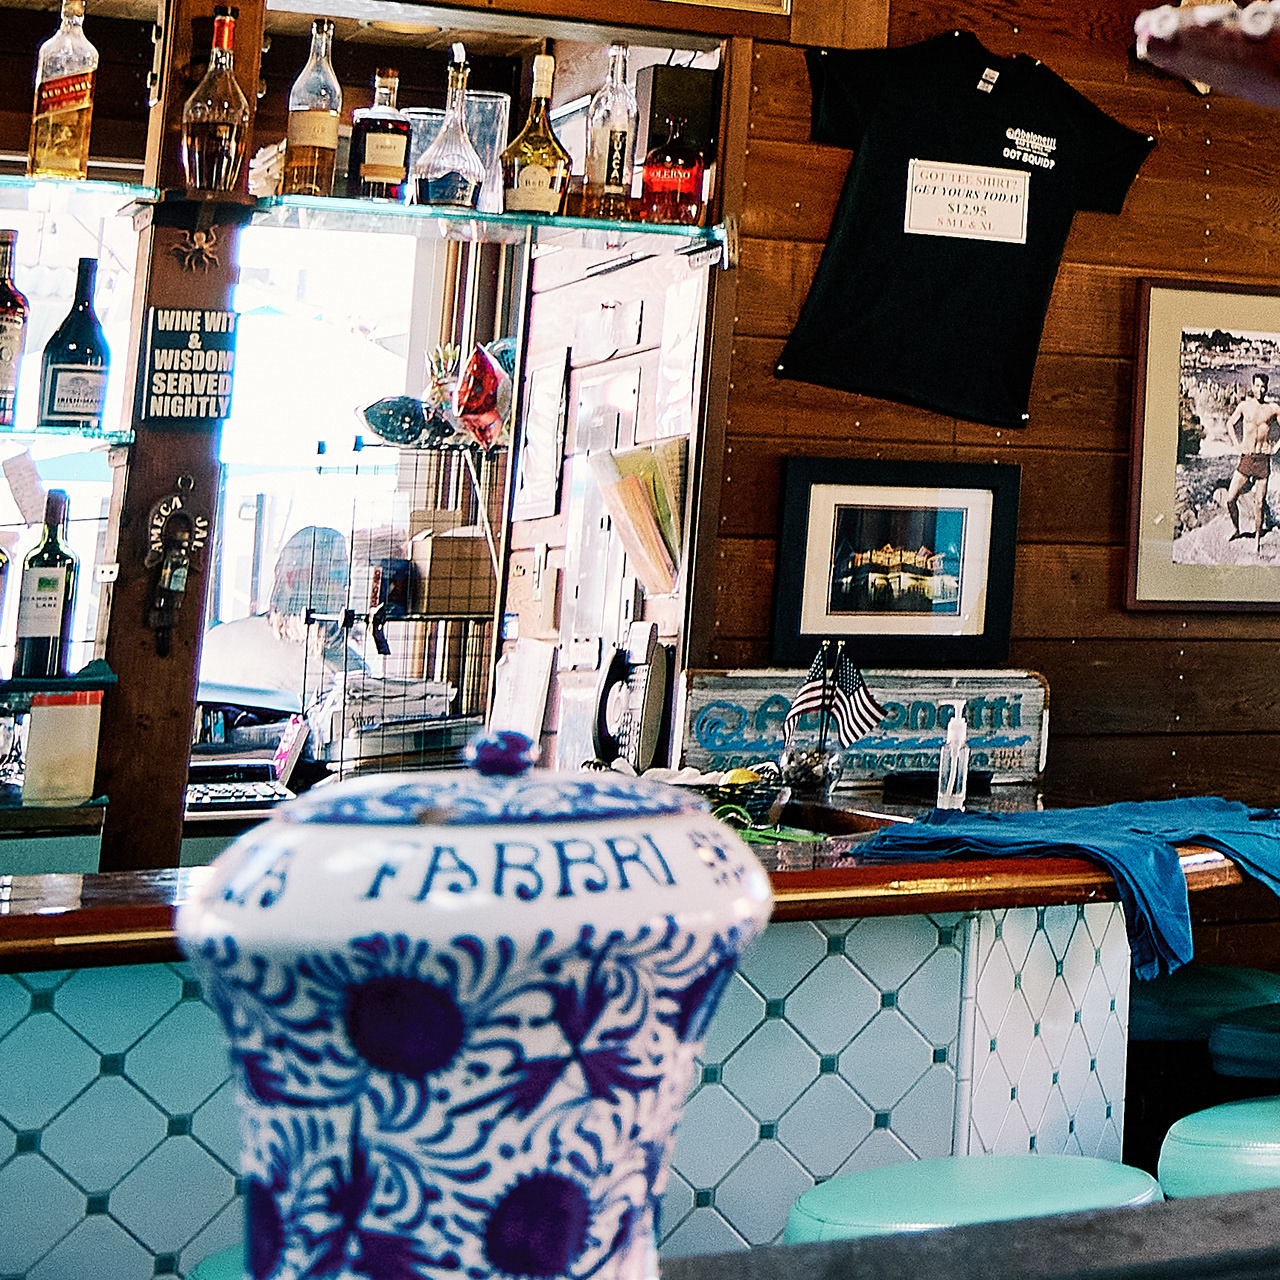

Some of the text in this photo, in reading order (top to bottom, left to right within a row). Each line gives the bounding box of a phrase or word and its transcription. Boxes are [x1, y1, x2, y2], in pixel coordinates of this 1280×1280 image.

[41, 80, 93, 100] RED LABEL
[612, 131, 626, 181] TUACA
[1022, 153, 1055, 169] SQUID?
[920, 170, 1018, 190] GOT TEE SHIRT?
[914, 184, 1022, 204] GET YOURS TODAY
[948, 203, 987, 216] $12.95
[157, 310, 236, 333] WINE WIT
[188, 333, 202, 350] &
[154, 349, 235, 372] WISDOM
[152, 372, 233, 396] SERVED
[150, 396, 231, 419] NIGHTLY
[150, 495, 183, 554] AMECA
[756, 693, 1024, 732] Aontti
[360, 831, 678, 902] FABBRI
